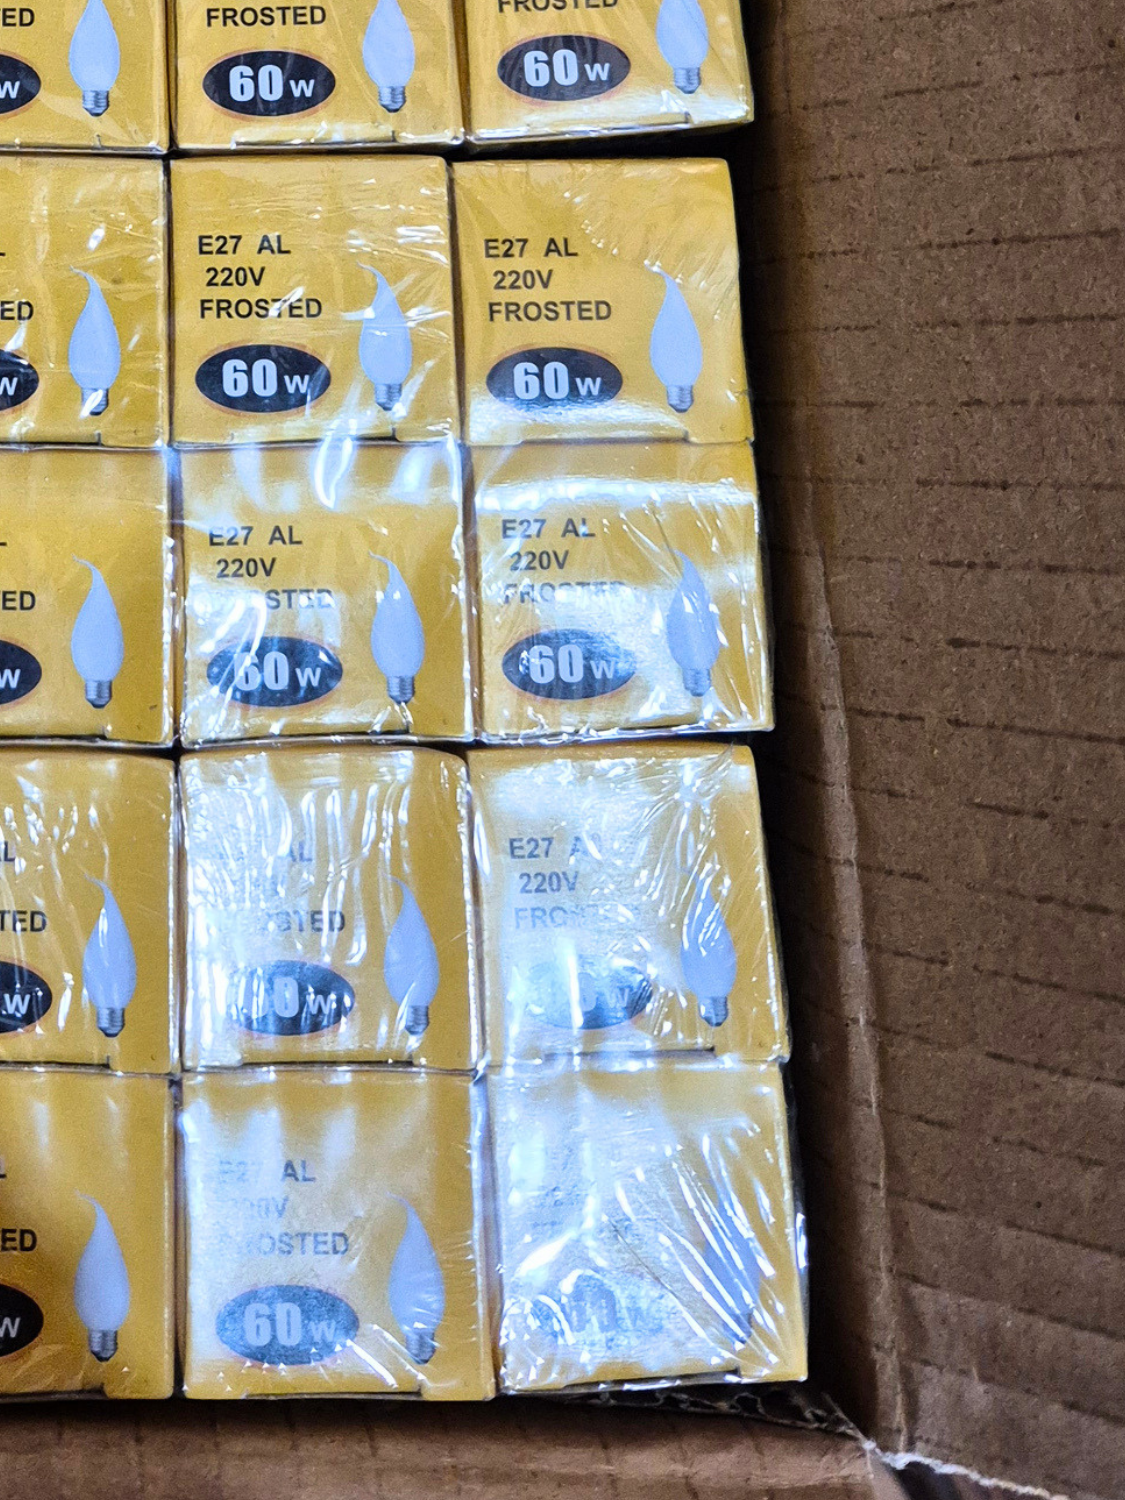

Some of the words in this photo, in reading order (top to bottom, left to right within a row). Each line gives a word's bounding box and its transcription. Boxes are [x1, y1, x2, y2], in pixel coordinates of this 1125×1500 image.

[206, 5, 326, 27] FROSTED
[485, 238, 528, 258] E27
[544, 238, 578, 257] AL
[494, 270, 552, 289] 220V
[489, 301, 611, 322] FROSTED
[268, 525, 302, 545] AL
[502, 519, 546, 539] E27
[561, 518, 596, 537] AL
[216, 557, 276, 578] 220V
[510, 550, 569, 571] 220V
[509, 837, 554, 859] E27
[519, 871, 579, 894] 220V
[282, 1160, 316, 1182] AL
